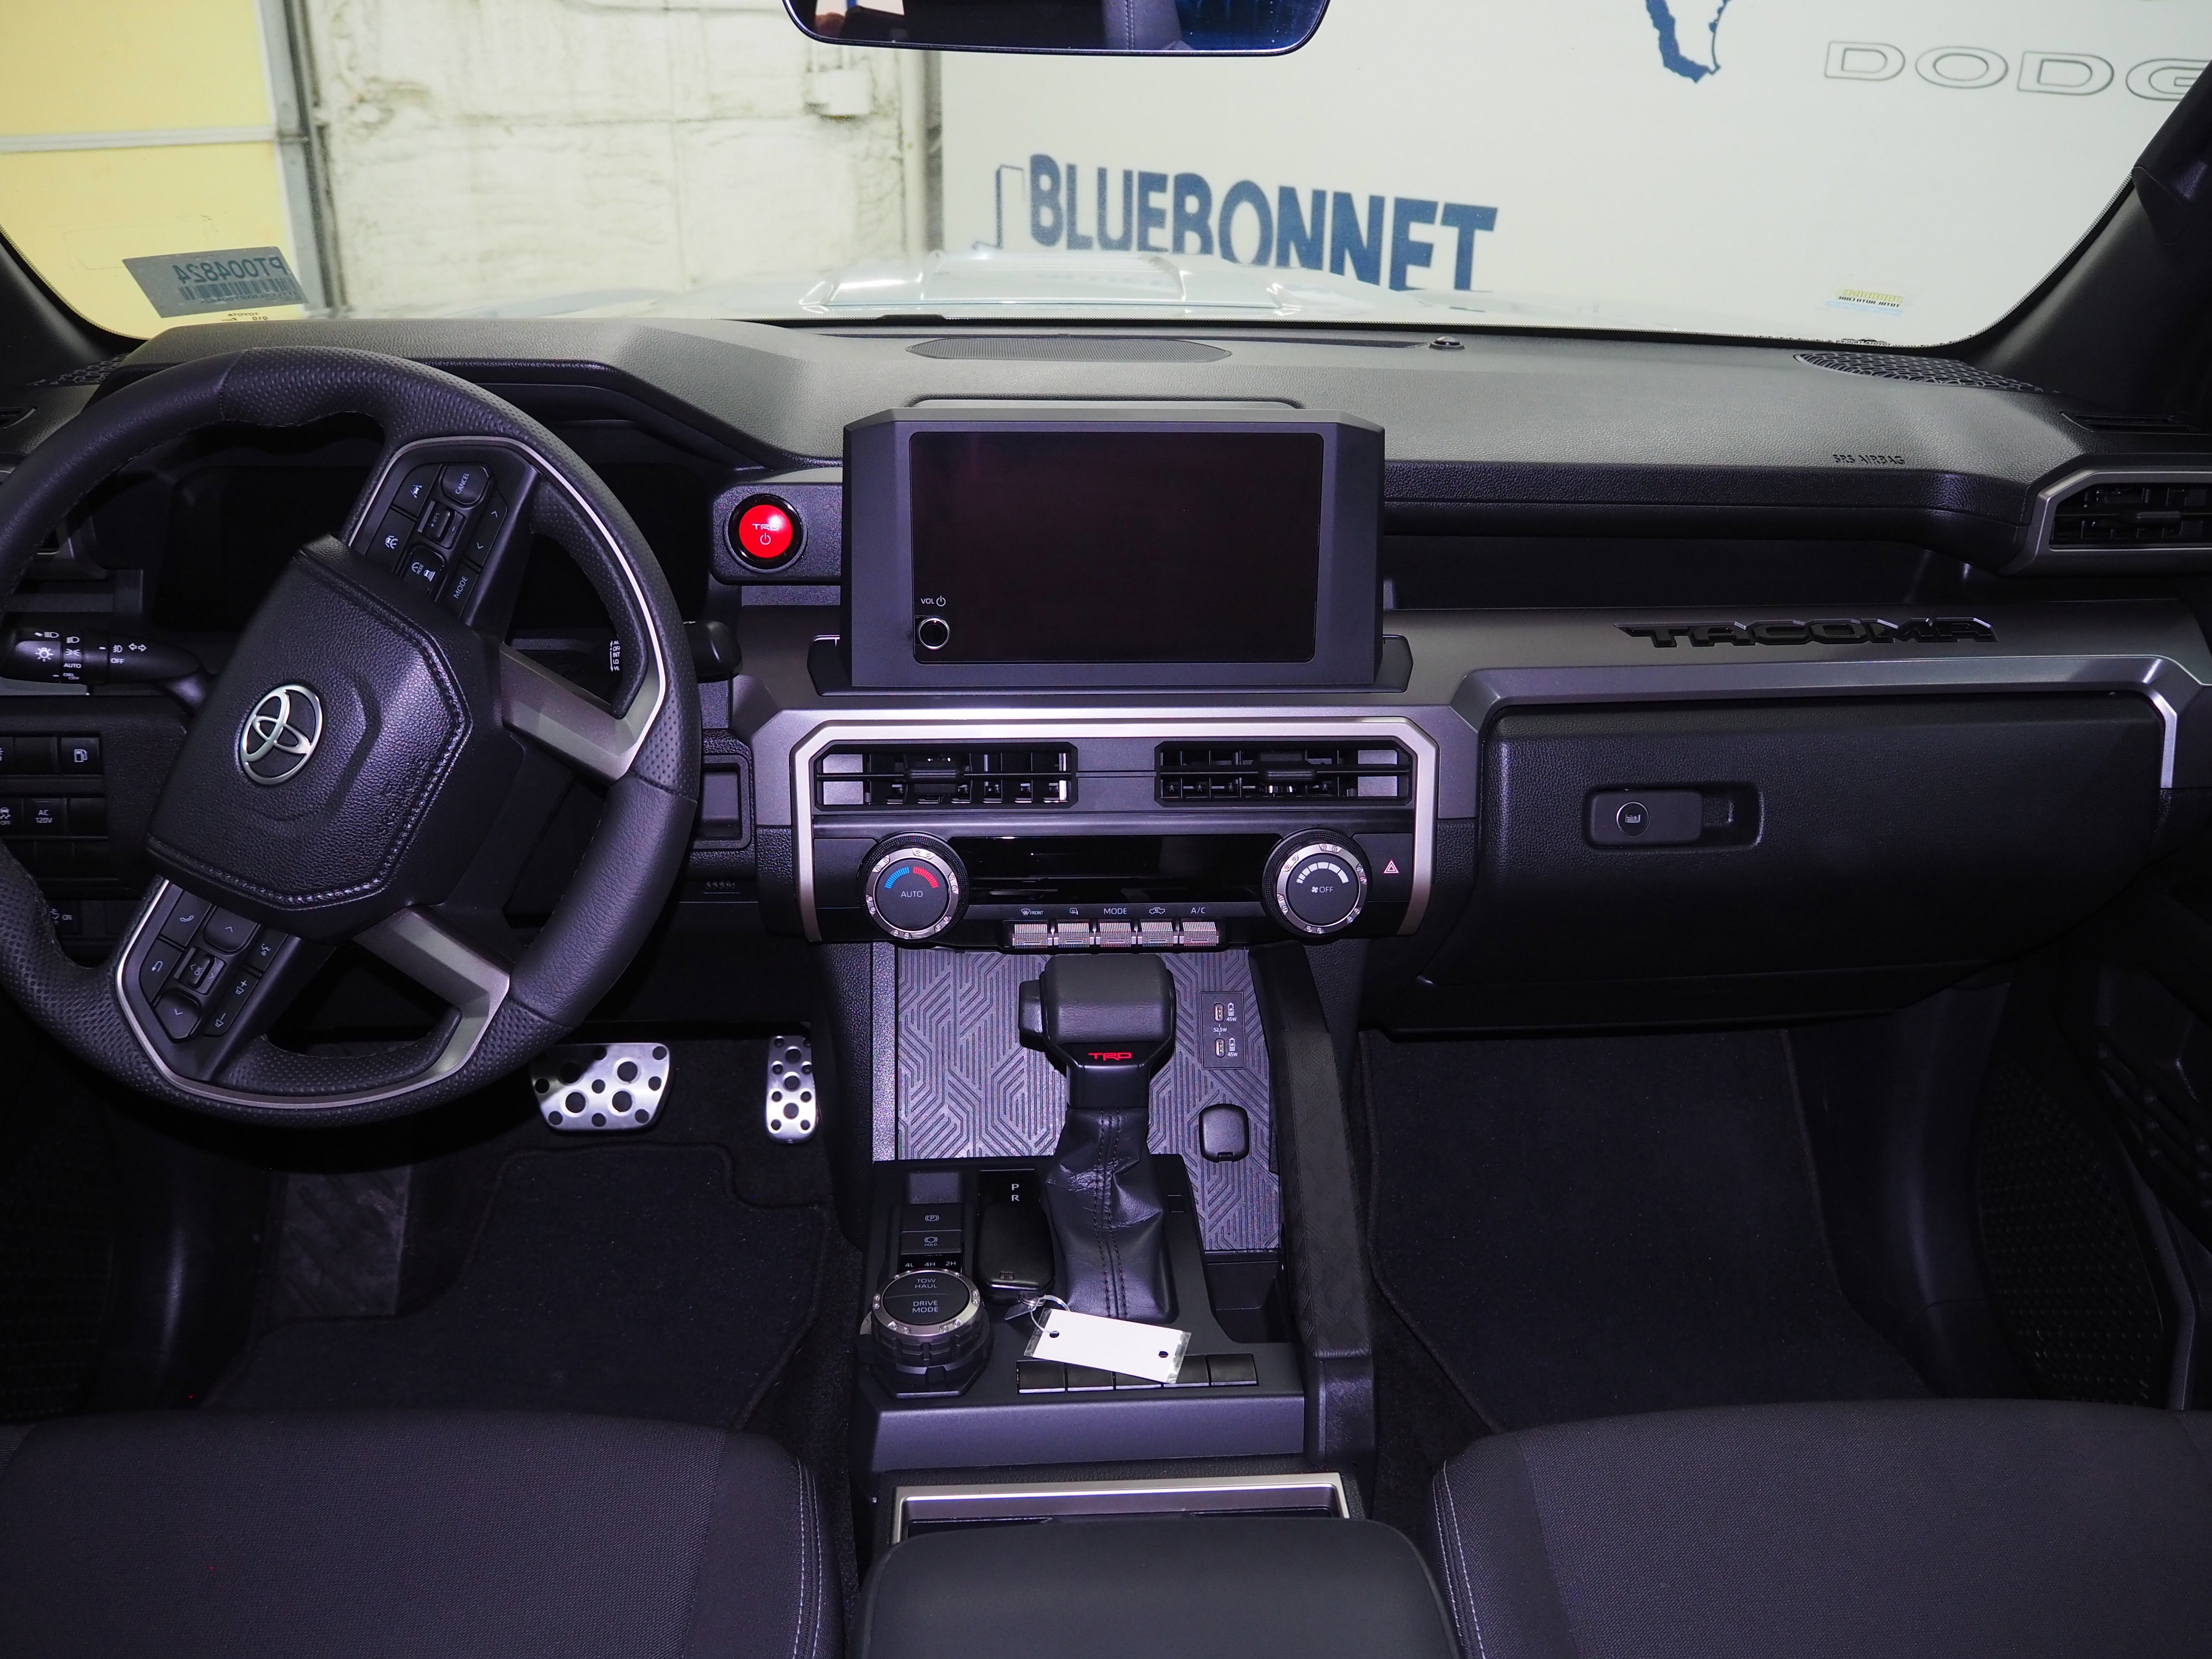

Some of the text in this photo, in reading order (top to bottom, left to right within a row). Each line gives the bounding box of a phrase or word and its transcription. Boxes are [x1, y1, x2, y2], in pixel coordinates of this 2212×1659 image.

[1030, 154, 1498, 291] BLUEBONNET
[1833, 455, 1906, 464] SRS AIRBAG
[455, 473, 470, 494] CANCEL
[751, 523, 779, 531] TRD
[453, 576, 468, 599] MODE
[1613, 616, 1999, 648] TACOMA
[194, 966, 203, 975] OK
[1088, 1052, 1132, 1061] TRD
